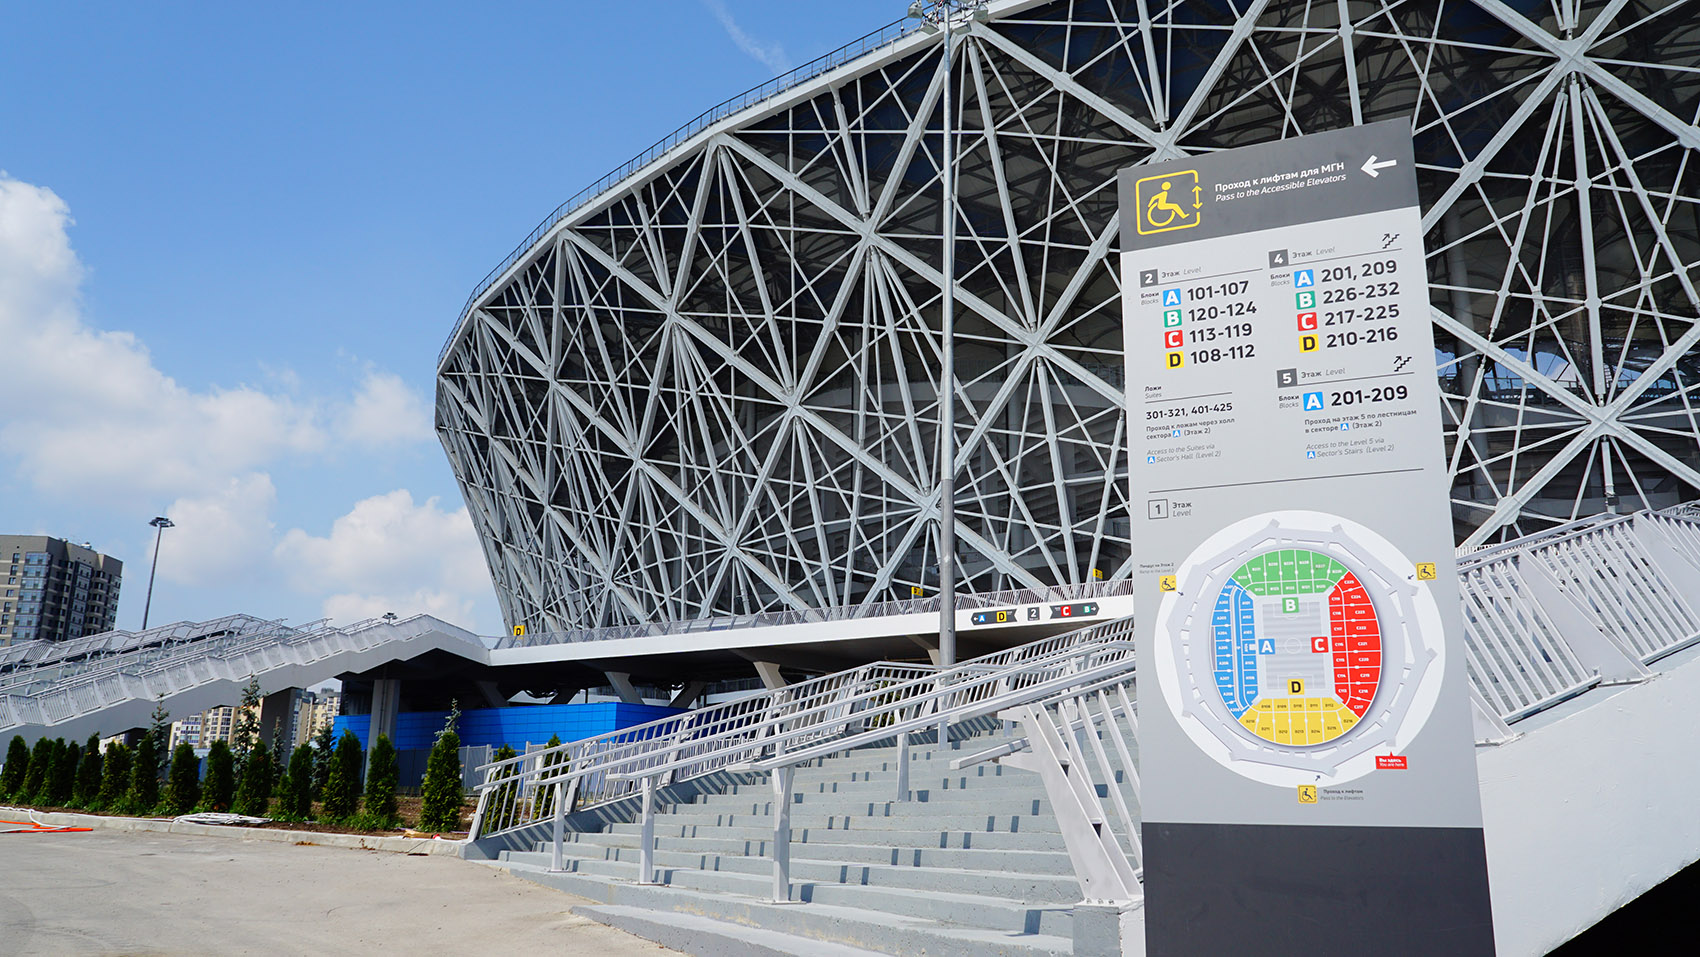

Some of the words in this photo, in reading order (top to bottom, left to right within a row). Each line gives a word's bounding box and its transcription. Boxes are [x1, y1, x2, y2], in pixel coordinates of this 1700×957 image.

[1215, 179, 1250, 193] Проход
[1260, 171, 1298, 185] лифтам
[1300, 168, 1318, 181] для
[1321, 162, 1344, 172] МГН
[1215, 192, 1234, 202] Pass
[1237, 191, 1244, 199] to
[1246, 188, 1259, 197] the
[1261, 181, 1305, 195] Accessible
[1307, 174, 1346, 187] Elevators
[1274, 254, 1284, 264] 4
[1292, 251, 1312, 259] Этаж
[1316, 247, 1336, 255] Level
[1145, 274, 1153, 283] 2
[1183, 267, 1201, 275] Level
[1270, 272, 1291, 280] Блоки
[1296, 271, 1312, 286] A
[1321, 265, 1357, 283] 201,
[1361, 259, 1397, 277] 209
[1270, 279, 1290, 287] Blocks
[1165, 291, 1179, 305] A
[1187, 281, 1249, 301] 101-107
[1299, 293, 1313, 307] B
[1323, 281, 1400, 304] 226-232
[1167, 311, 1180, 326] B
[1188, 301, 1257, 322] 120-124
[1301, 314, 1314, 329] C
[1324, 304, 1400, 326] 217-225
[1168, 332, 1180, 347] C
[1189, 323, 1252, 343] 113-119
[1303, 336, 1315, 351] D
[1326, 326, 1398, 348] 210-216
[1169, 353, 1181, 368] D
[1190, 344, 1255, 364] 108-112
[1282, 372, 1292, 384] 5
[1301, 371, 1322, 379] Этаж
[1325, 367, 1346, 376] Level
[1278, 394, 1300, 402] Блоки
[1306, 394, 1322, 409] A
[1331, 385, 1408, 406] 201-209
[1146, 408, 1189, 420] 301-321,
[1191, 402, 1233, 414] 401-425
[1279, 401, 1299, 409] Blocks
[1304, 417, 1331, 426] Проход
[1342, 414, 1359, 422] этаж
[1377, 409, 1417, 418] лестницам
[1146, 425, 1170, 433] Проход
[1310, 425, 1339, 433] секторе
[1352, 422, 1373, 430] (Этаж
[1146, 432, 1172, 440] сектора
[1184, 429, 1203, 437] (Этаж
[1350, 438, 1368, 446] Level
[1155, 505, 1161, 514] 1
[1172, 509, 1192, 517] Level
[1062, 606, 1070, 616] C
[1285, 599, 1296, 611] B
[998, 612, 1005, 621] D
[1030, 609, 1037, 617] 2
[1261, 640, 1273, 653] A
[1314, 638, 1325, 651] C
[1291, 681, 1302, 693] D
